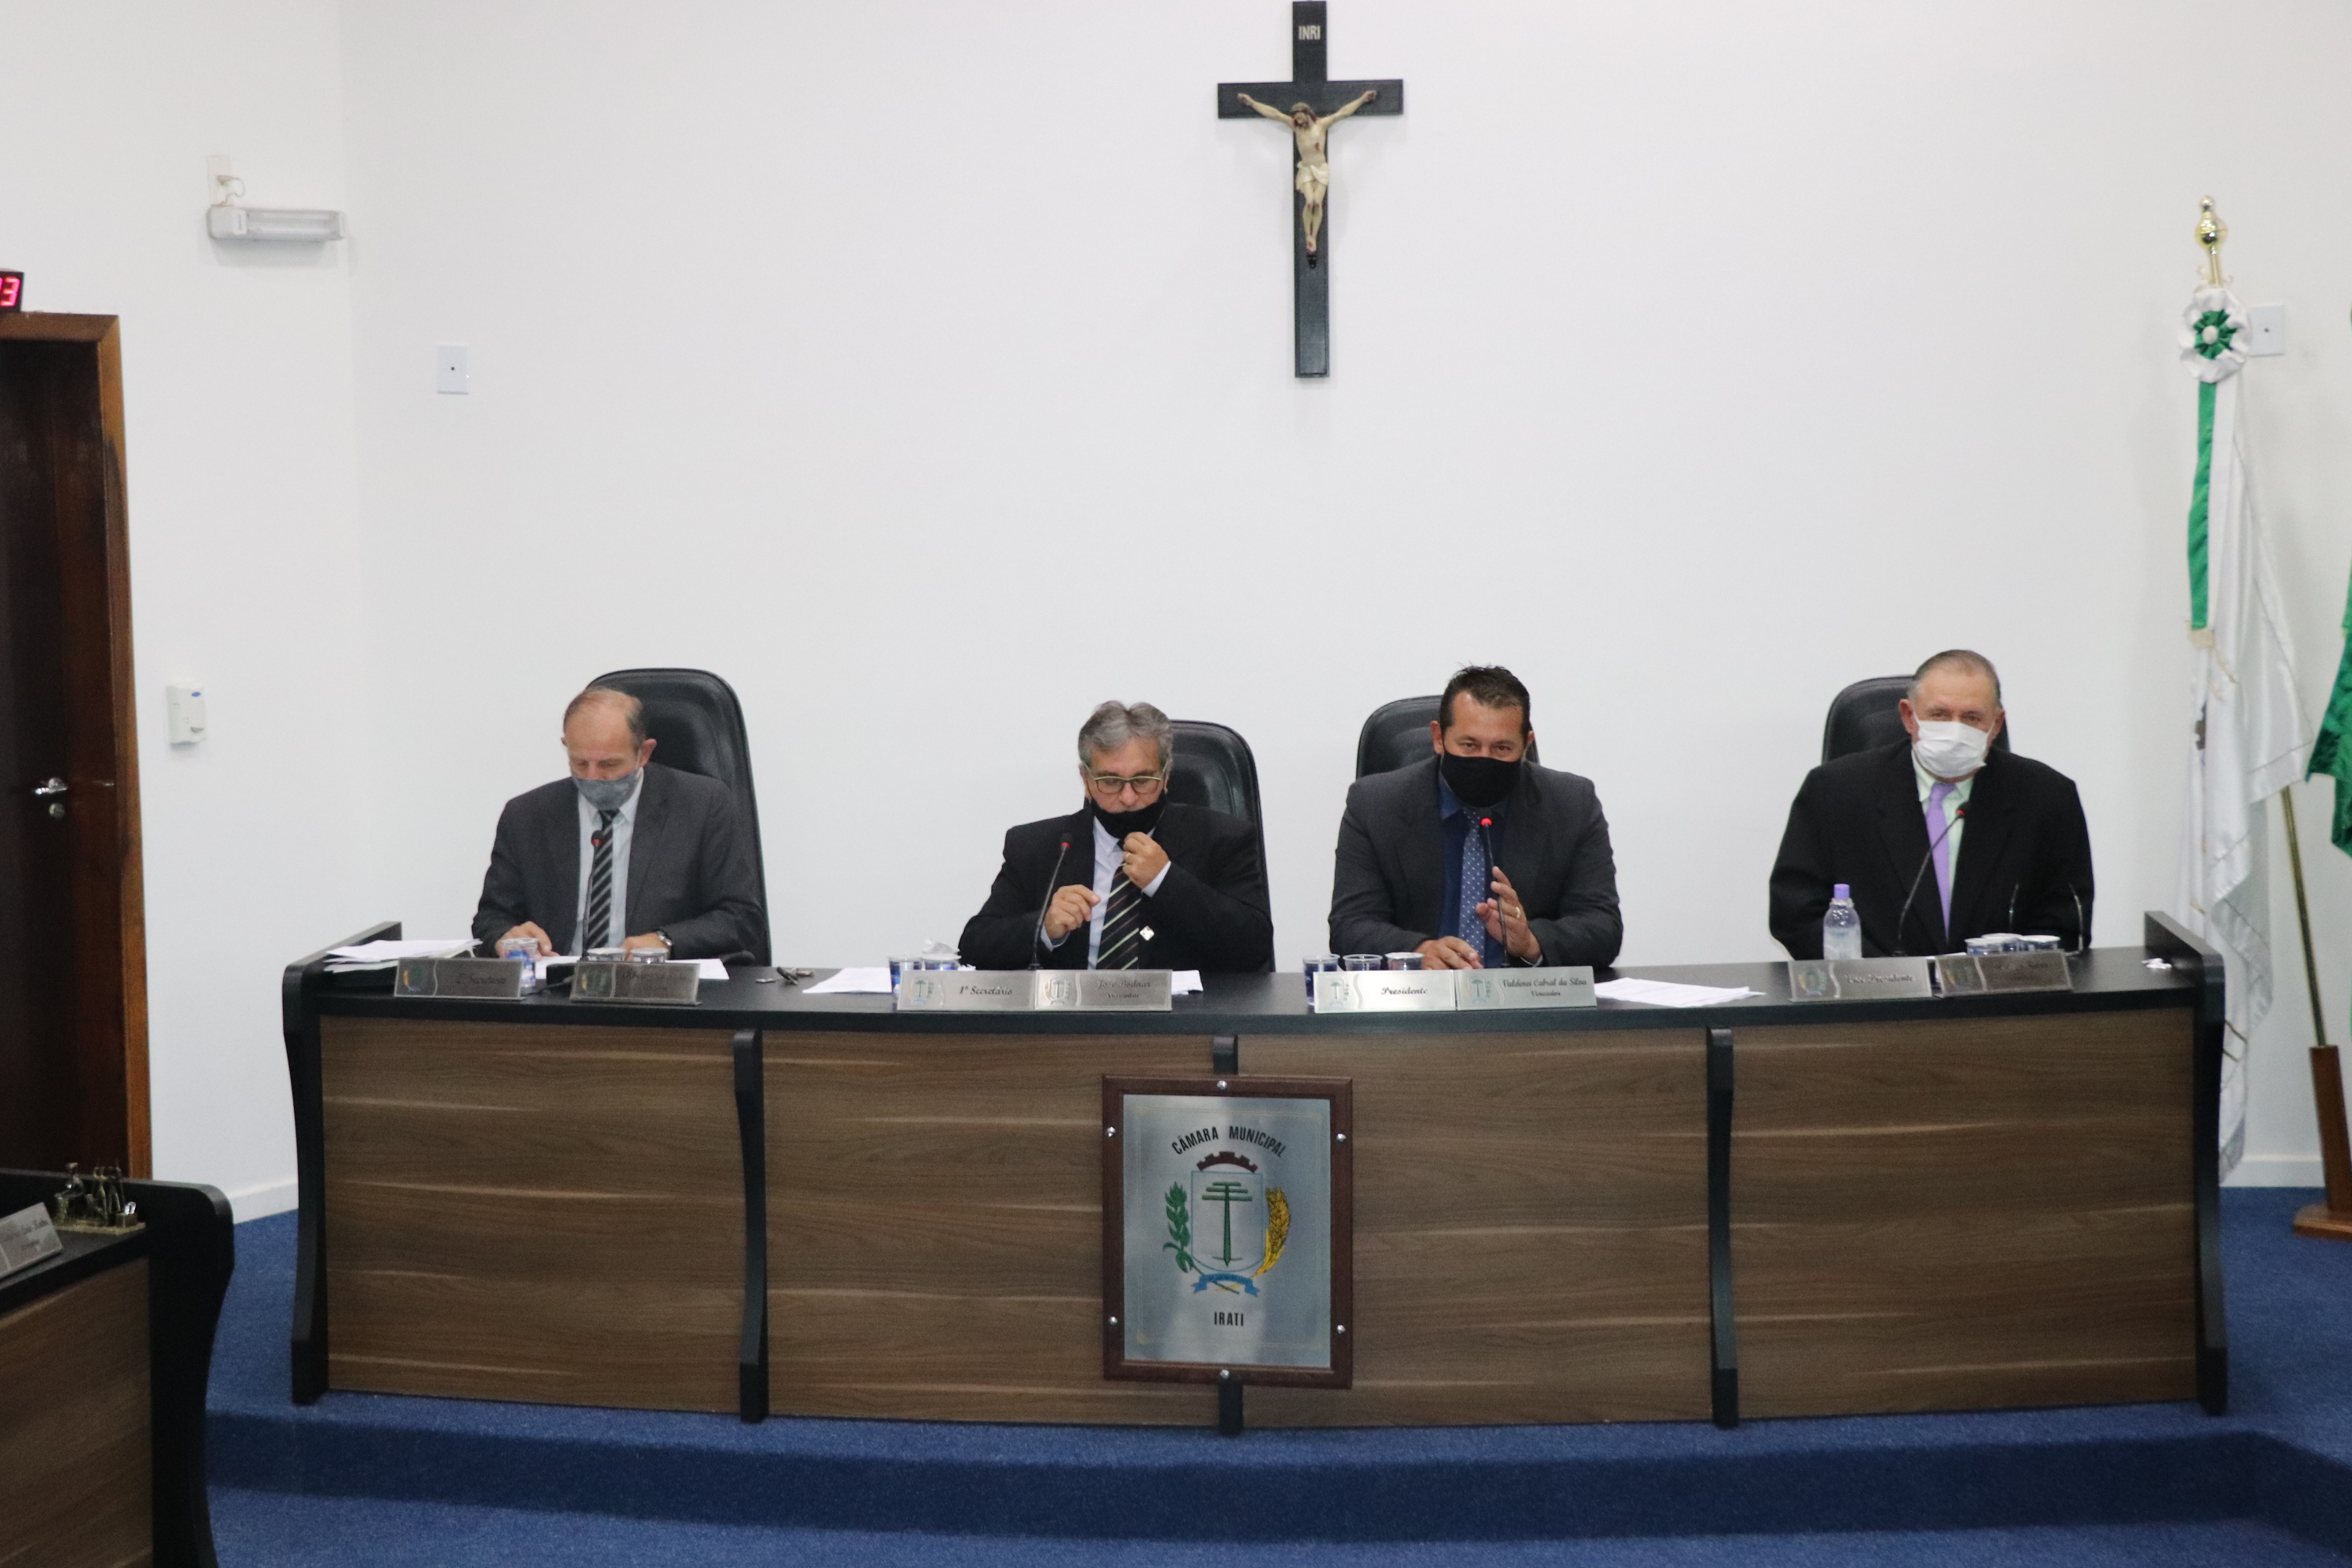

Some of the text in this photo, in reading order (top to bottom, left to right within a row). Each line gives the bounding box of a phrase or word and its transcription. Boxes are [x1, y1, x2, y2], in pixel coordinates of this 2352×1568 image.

[1298, 24, 1321, 40] INRI
[1381, 986, 1428, 995] Presidente
[1228, 1125, 1287, 1159] MUNICIPAL
[1214, 1311, 1245, 1327] IRATI
